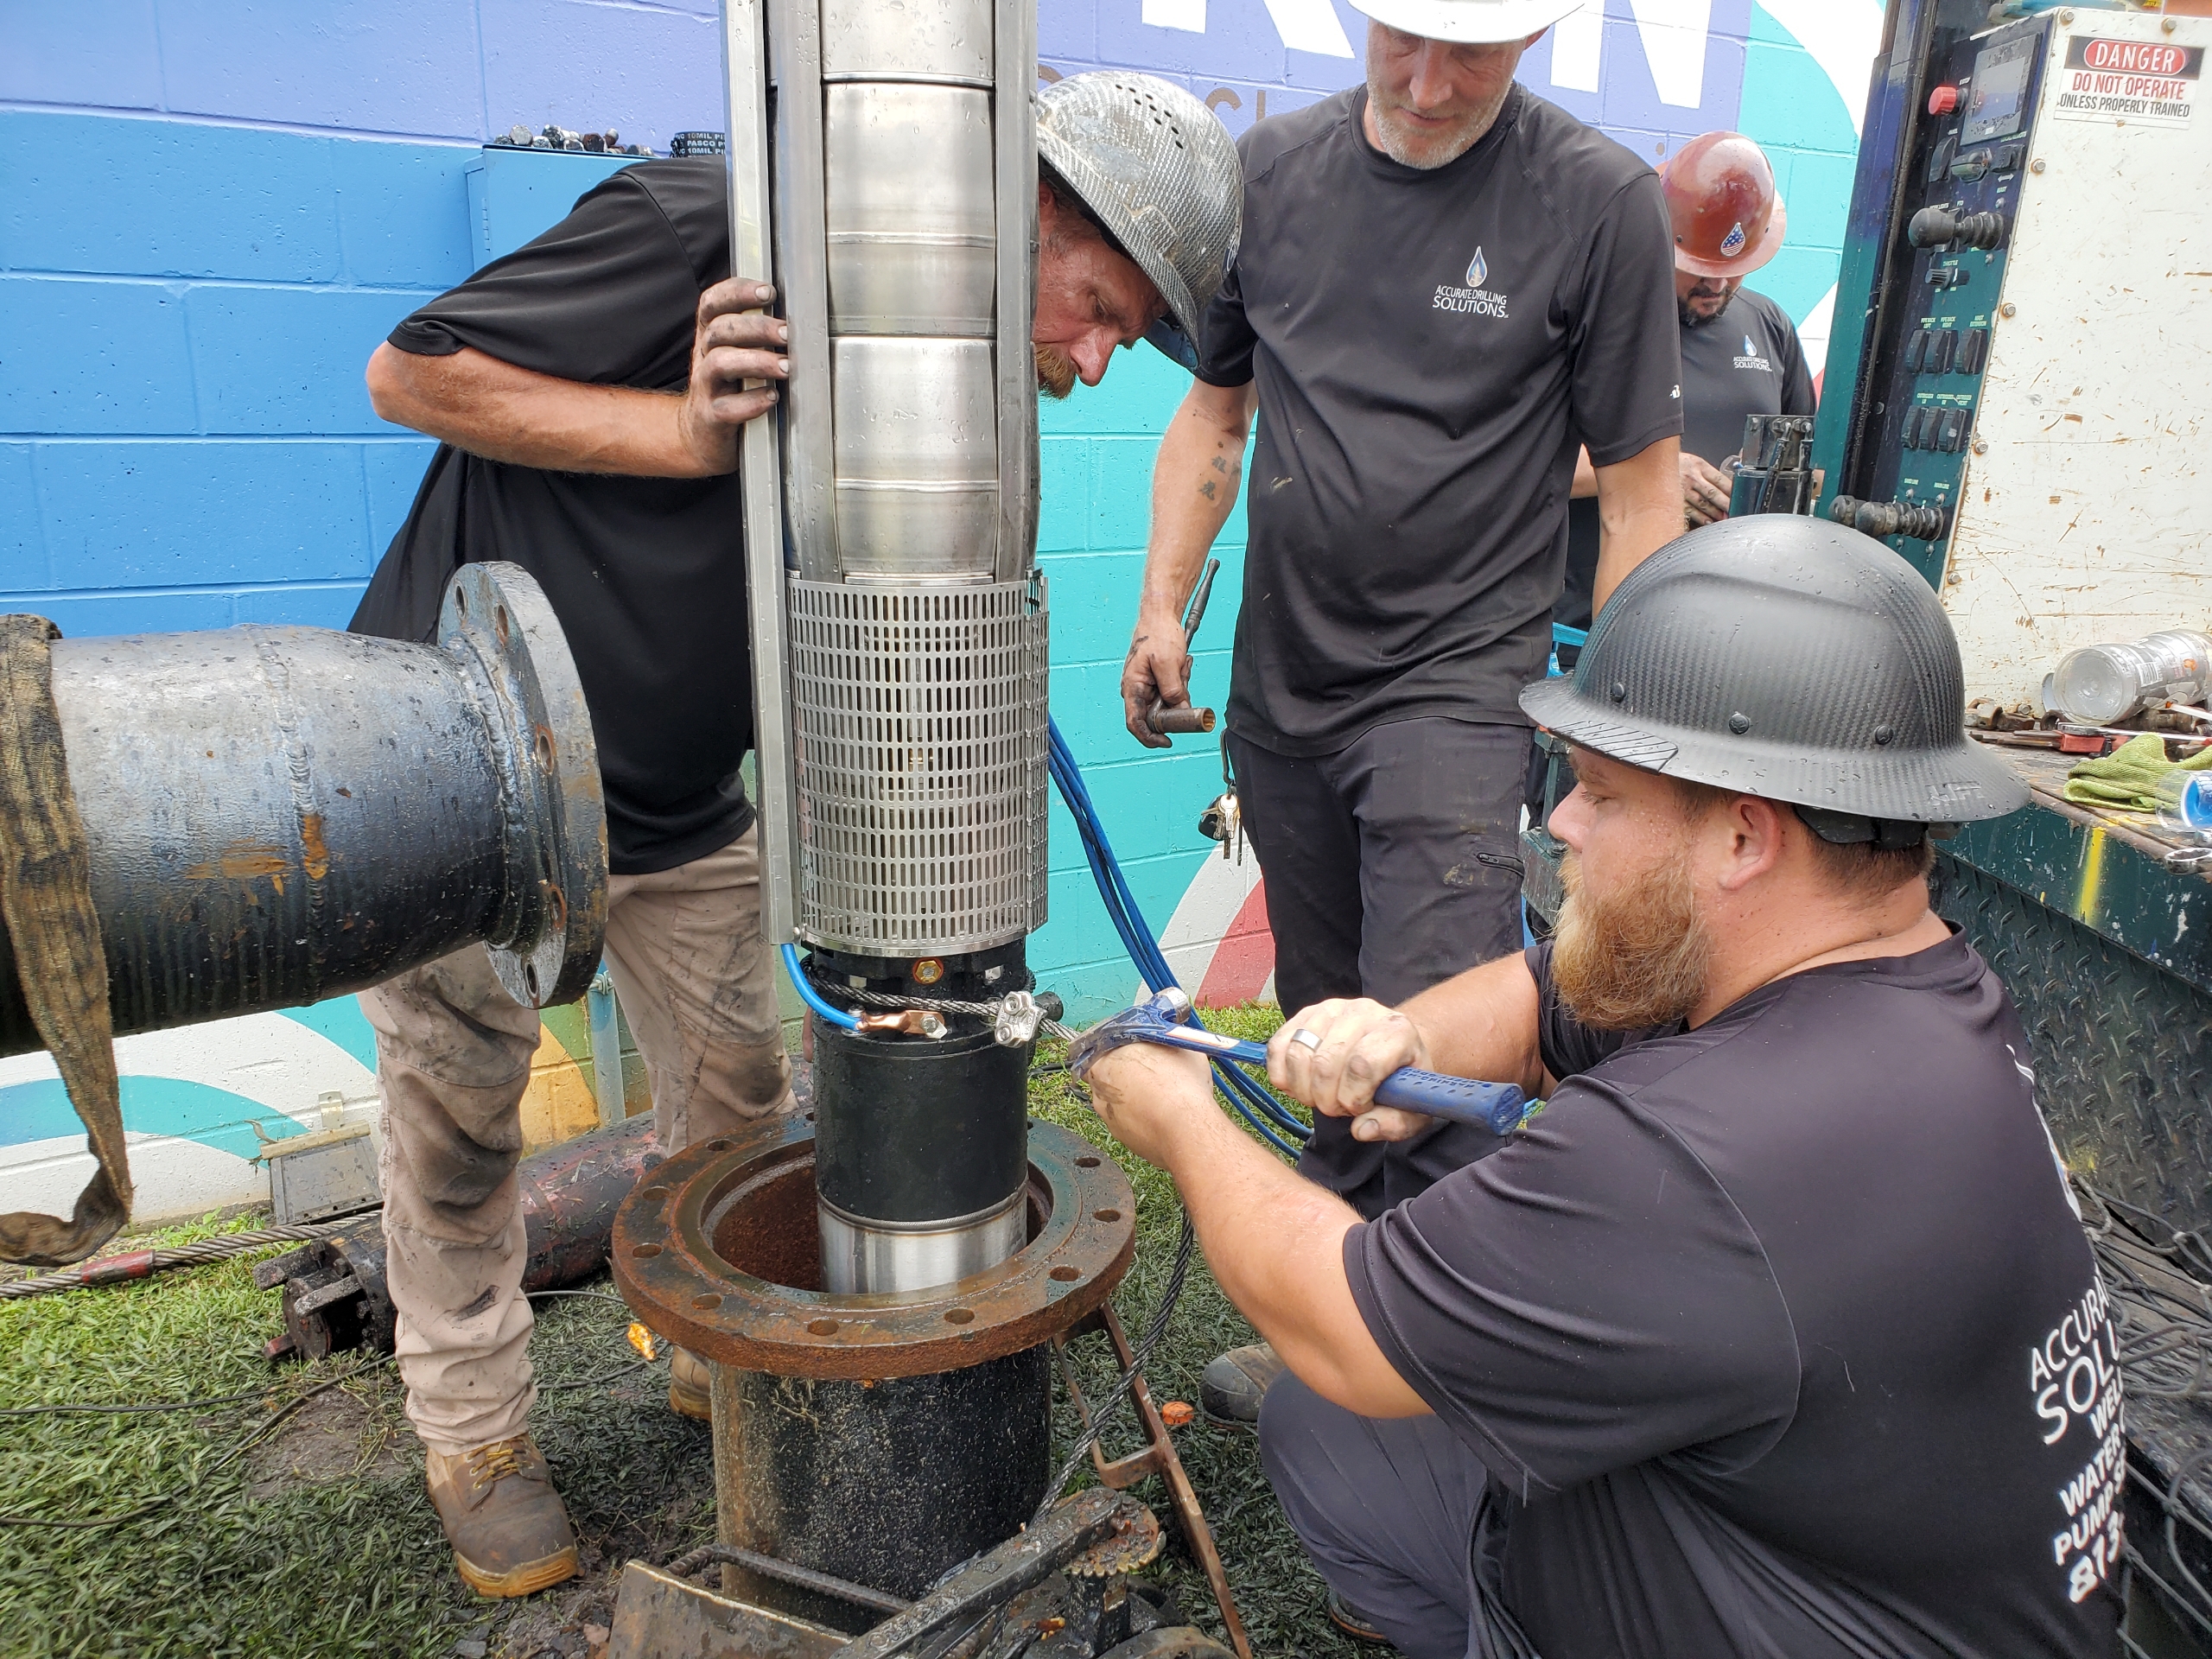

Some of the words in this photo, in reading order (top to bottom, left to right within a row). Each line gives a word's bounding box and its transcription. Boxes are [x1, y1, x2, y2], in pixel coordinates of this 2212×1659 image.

[2094, 43, 2176, 72] DANGER
[2072, 72, 2092, 92] DO
[2094, 74, 2123, 94] NOT
[2125, 77, 2186, 100] OPERATE
[2060, 93, 2098, 110] UNLESS
[2099, 97, 2148, 113] PROPERLY
[2150, 101, 2190, 118] TRAINED
[1433, 296, 1506, 318] SOLUTIONS
[1435, 285, 1472, 300] ACCURATE
[1472, 289, 1507, 305] DRILLING
[1734, 361, 1770, 371] SOLUTIONS
[2032, 1268, 2111, 1393] ACCURA
[2059, 1421, 2121, 1517] WATER
[2053, 1480, 2114, 1567] PUMP
